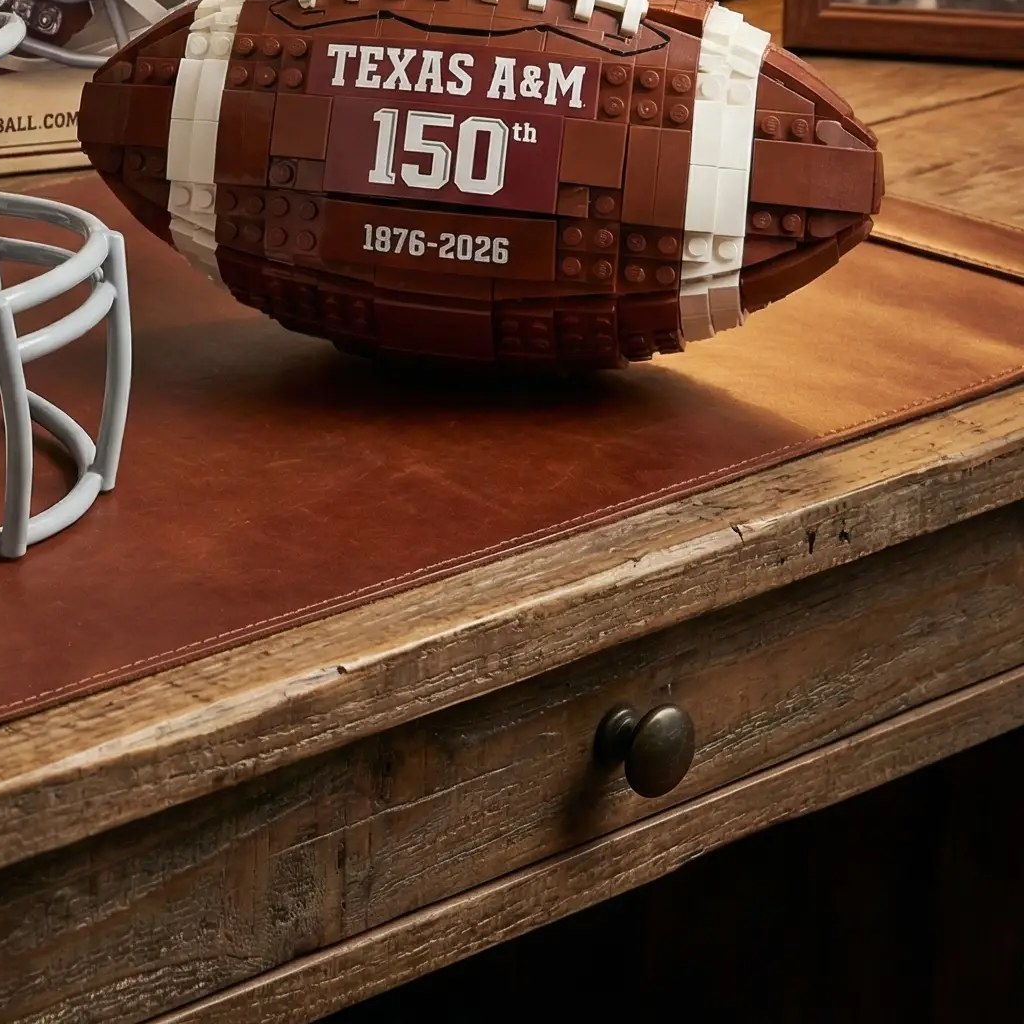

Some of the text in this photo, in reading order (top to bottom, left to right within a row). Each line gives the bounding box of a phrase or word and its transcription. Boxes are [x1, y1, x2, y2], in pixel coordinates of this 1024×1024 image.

[327, 43, 587, 109] TEXAS A&M
[368, 107, 538, 196] 150th
[363, 223, 510, 265] 1876-2026
